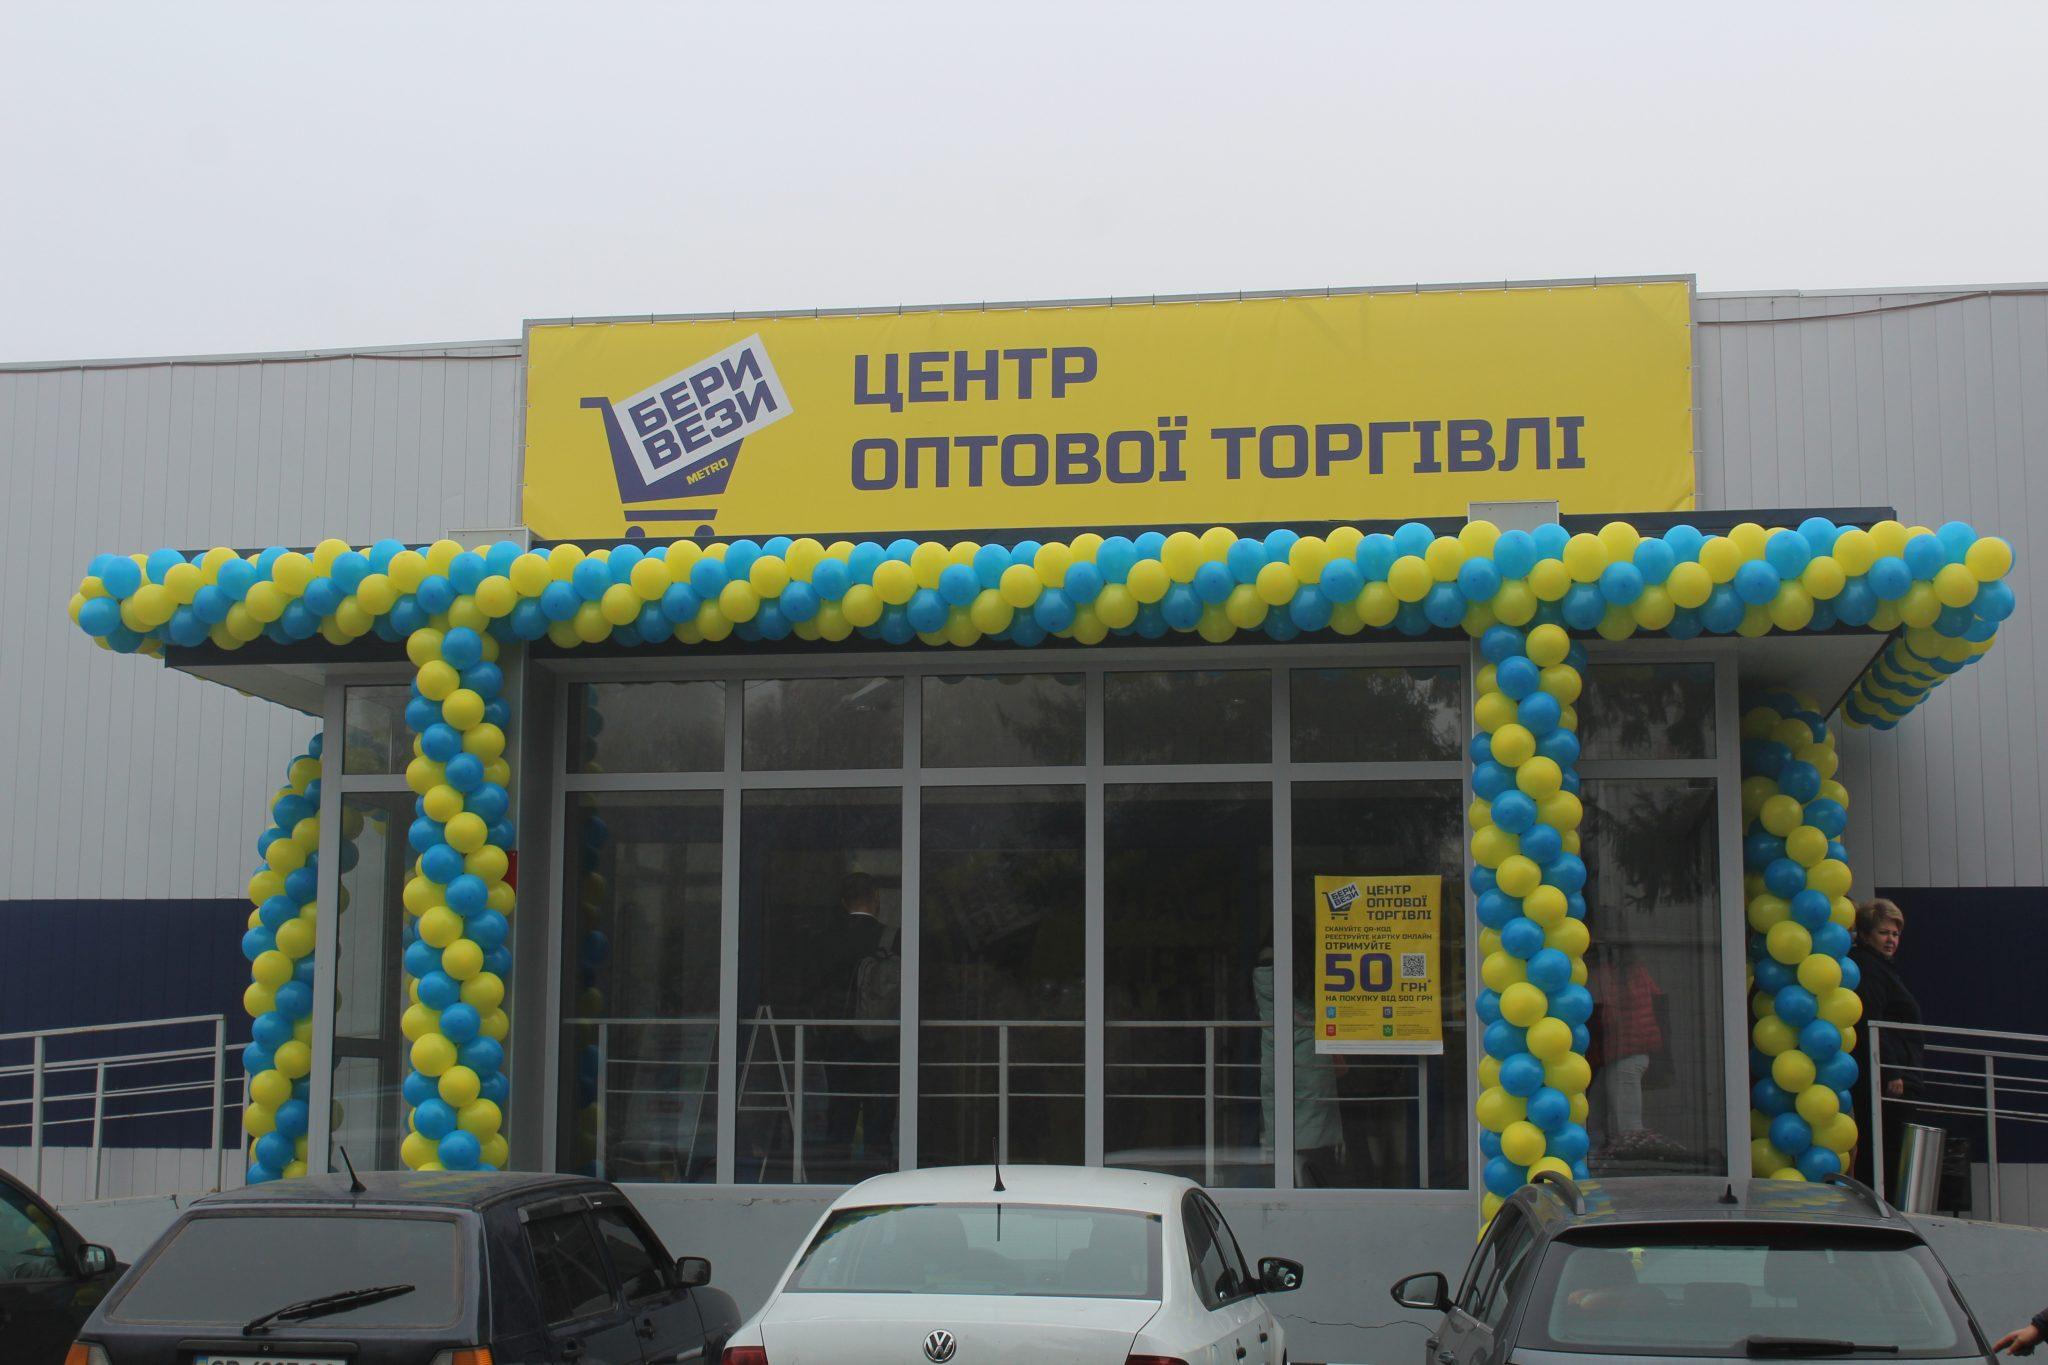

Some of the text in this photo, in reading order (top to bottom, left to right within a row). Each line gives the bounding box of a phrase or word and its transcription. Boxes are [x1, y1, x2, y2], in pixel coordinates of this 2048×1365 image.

[853, 346, 1098, 413] ЦЕНТР
[628, 347, 763, 437] БЕРИ
[641, 379, 778, 470] ВЕЗИ
[851, 415, 1586, 491] ОПТОВОЇ ТОРГІВЛІ
[686, 457, 729, 485] METRO
[1331, 884, 1355, 900] БЕРИ
[1334, 891, 1359, 906] ВЕЗИ
[1367, 885, 1411, 897] ЦЕНТР
[1367, 895, 1427, 908] ОПТОВОЇ
[1366, 910, 1432, 920] ТОРГІВЛІ
[1325, 940, 1391, 950] ОТРИМУЙТЕ
[1324, 953, 1393, 992] 50
[1381, 995, 1397, 1003] ВІД
